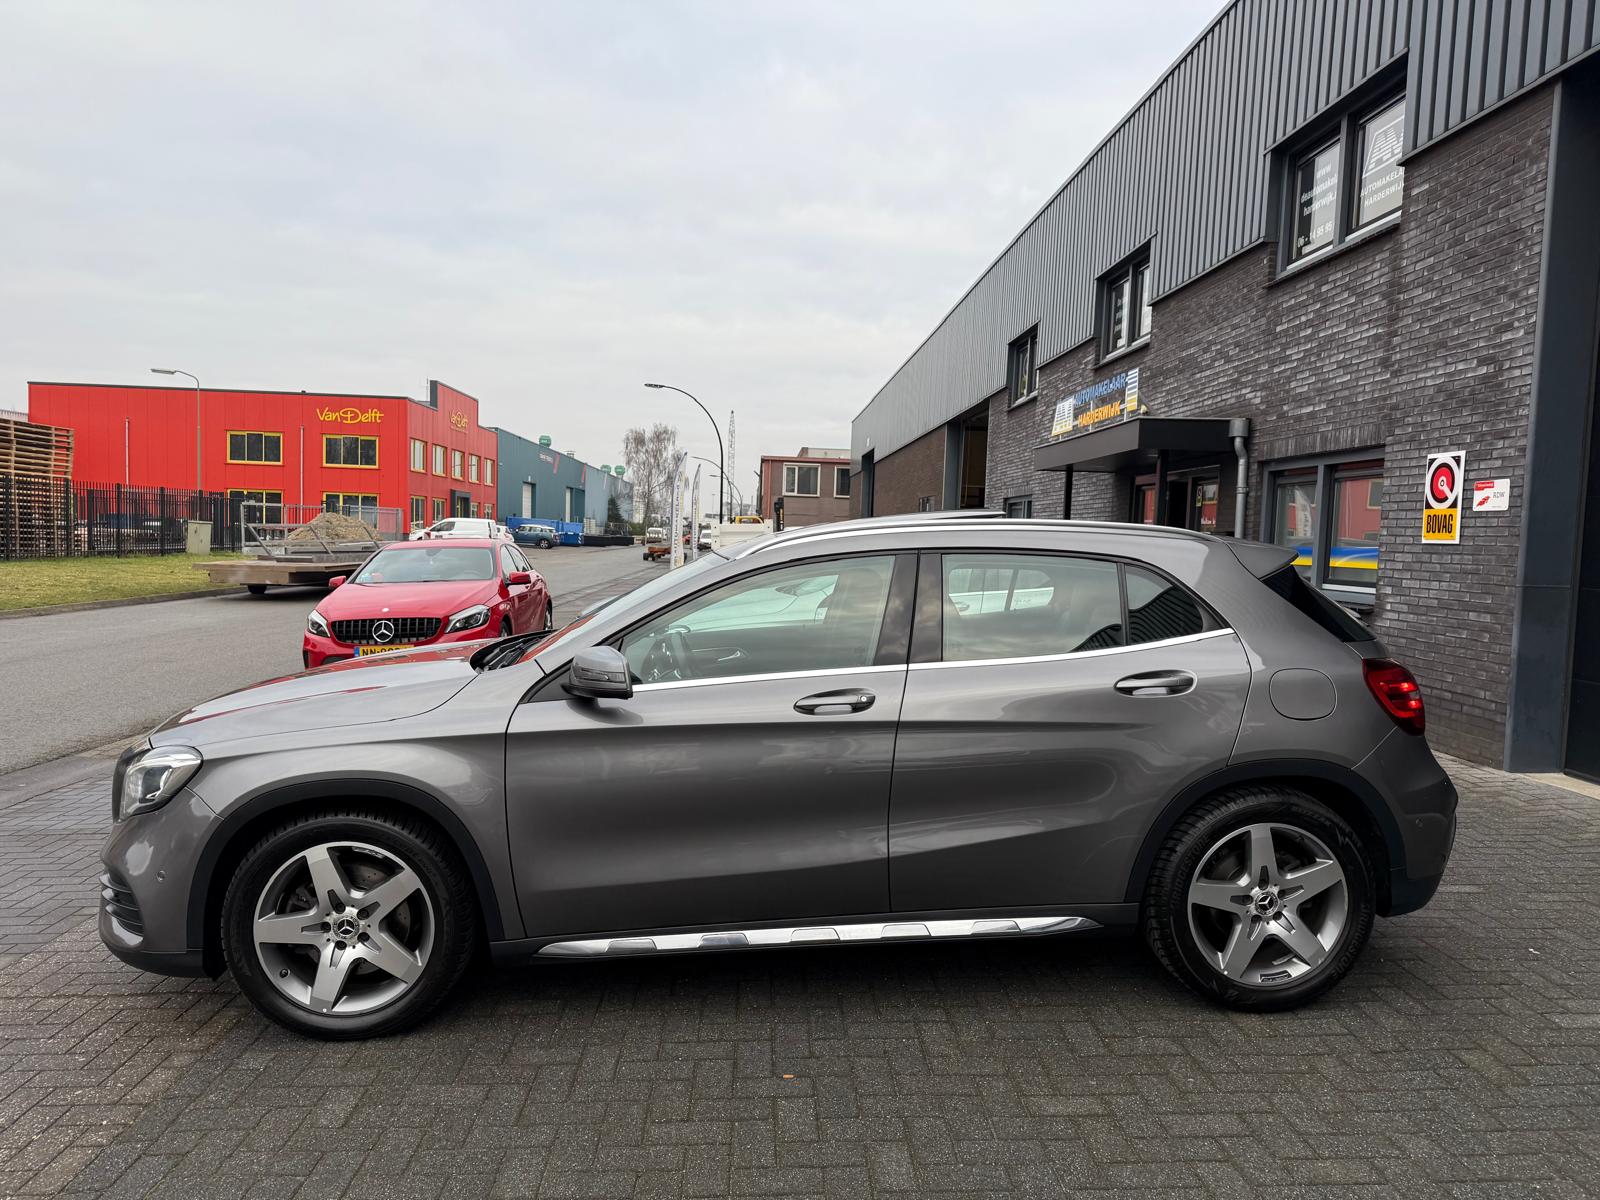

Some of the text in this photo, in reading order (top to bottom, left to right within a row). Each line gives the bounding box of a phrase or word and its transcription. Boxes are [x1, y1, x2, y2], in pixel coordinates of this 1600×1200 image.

[1074, 373, 1126, 407] AUTOMAKELAAR
[1078, 401, 1121, 427] HARDERWIJK
[1426, 513, 1453, 534] BOVAG
